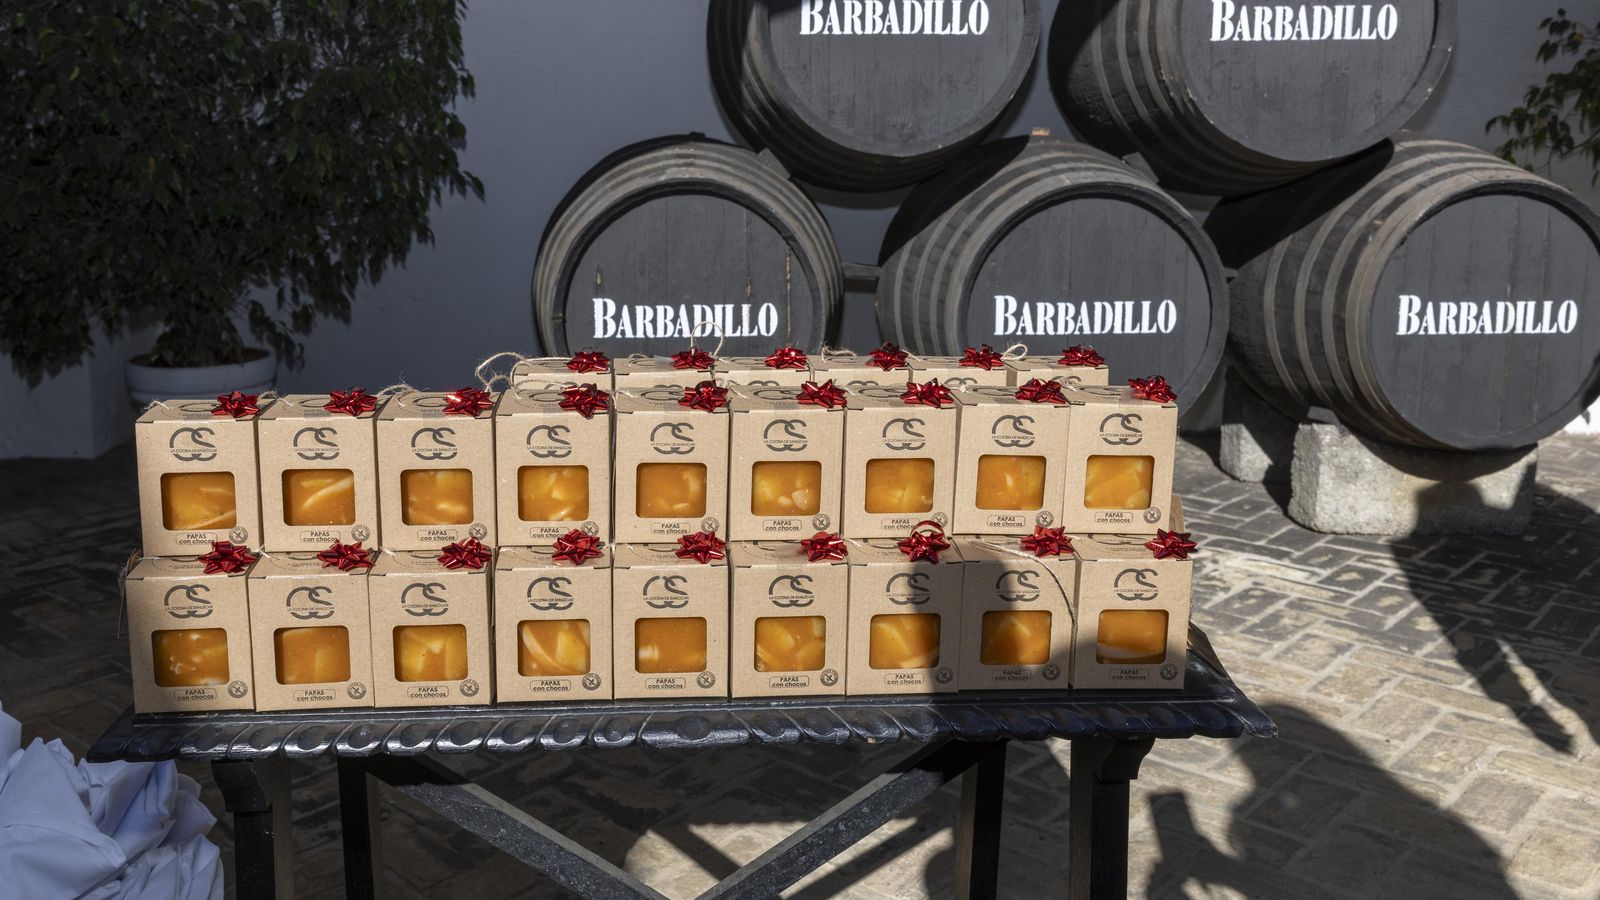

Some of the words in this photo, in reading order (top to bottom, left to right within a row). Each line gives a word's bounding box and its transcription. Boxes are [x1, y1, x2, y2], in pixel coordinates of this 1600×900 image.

[799, 0, 990, 36] BARBADILLO
[1209, 0, 1398, 42] BARBADILLO
[592, 297, 779, 340] BARBADILLO
[993, 295, 1178, 336] BARBADILLO
[1396, 295, 1578, 336] BARBADILLO
